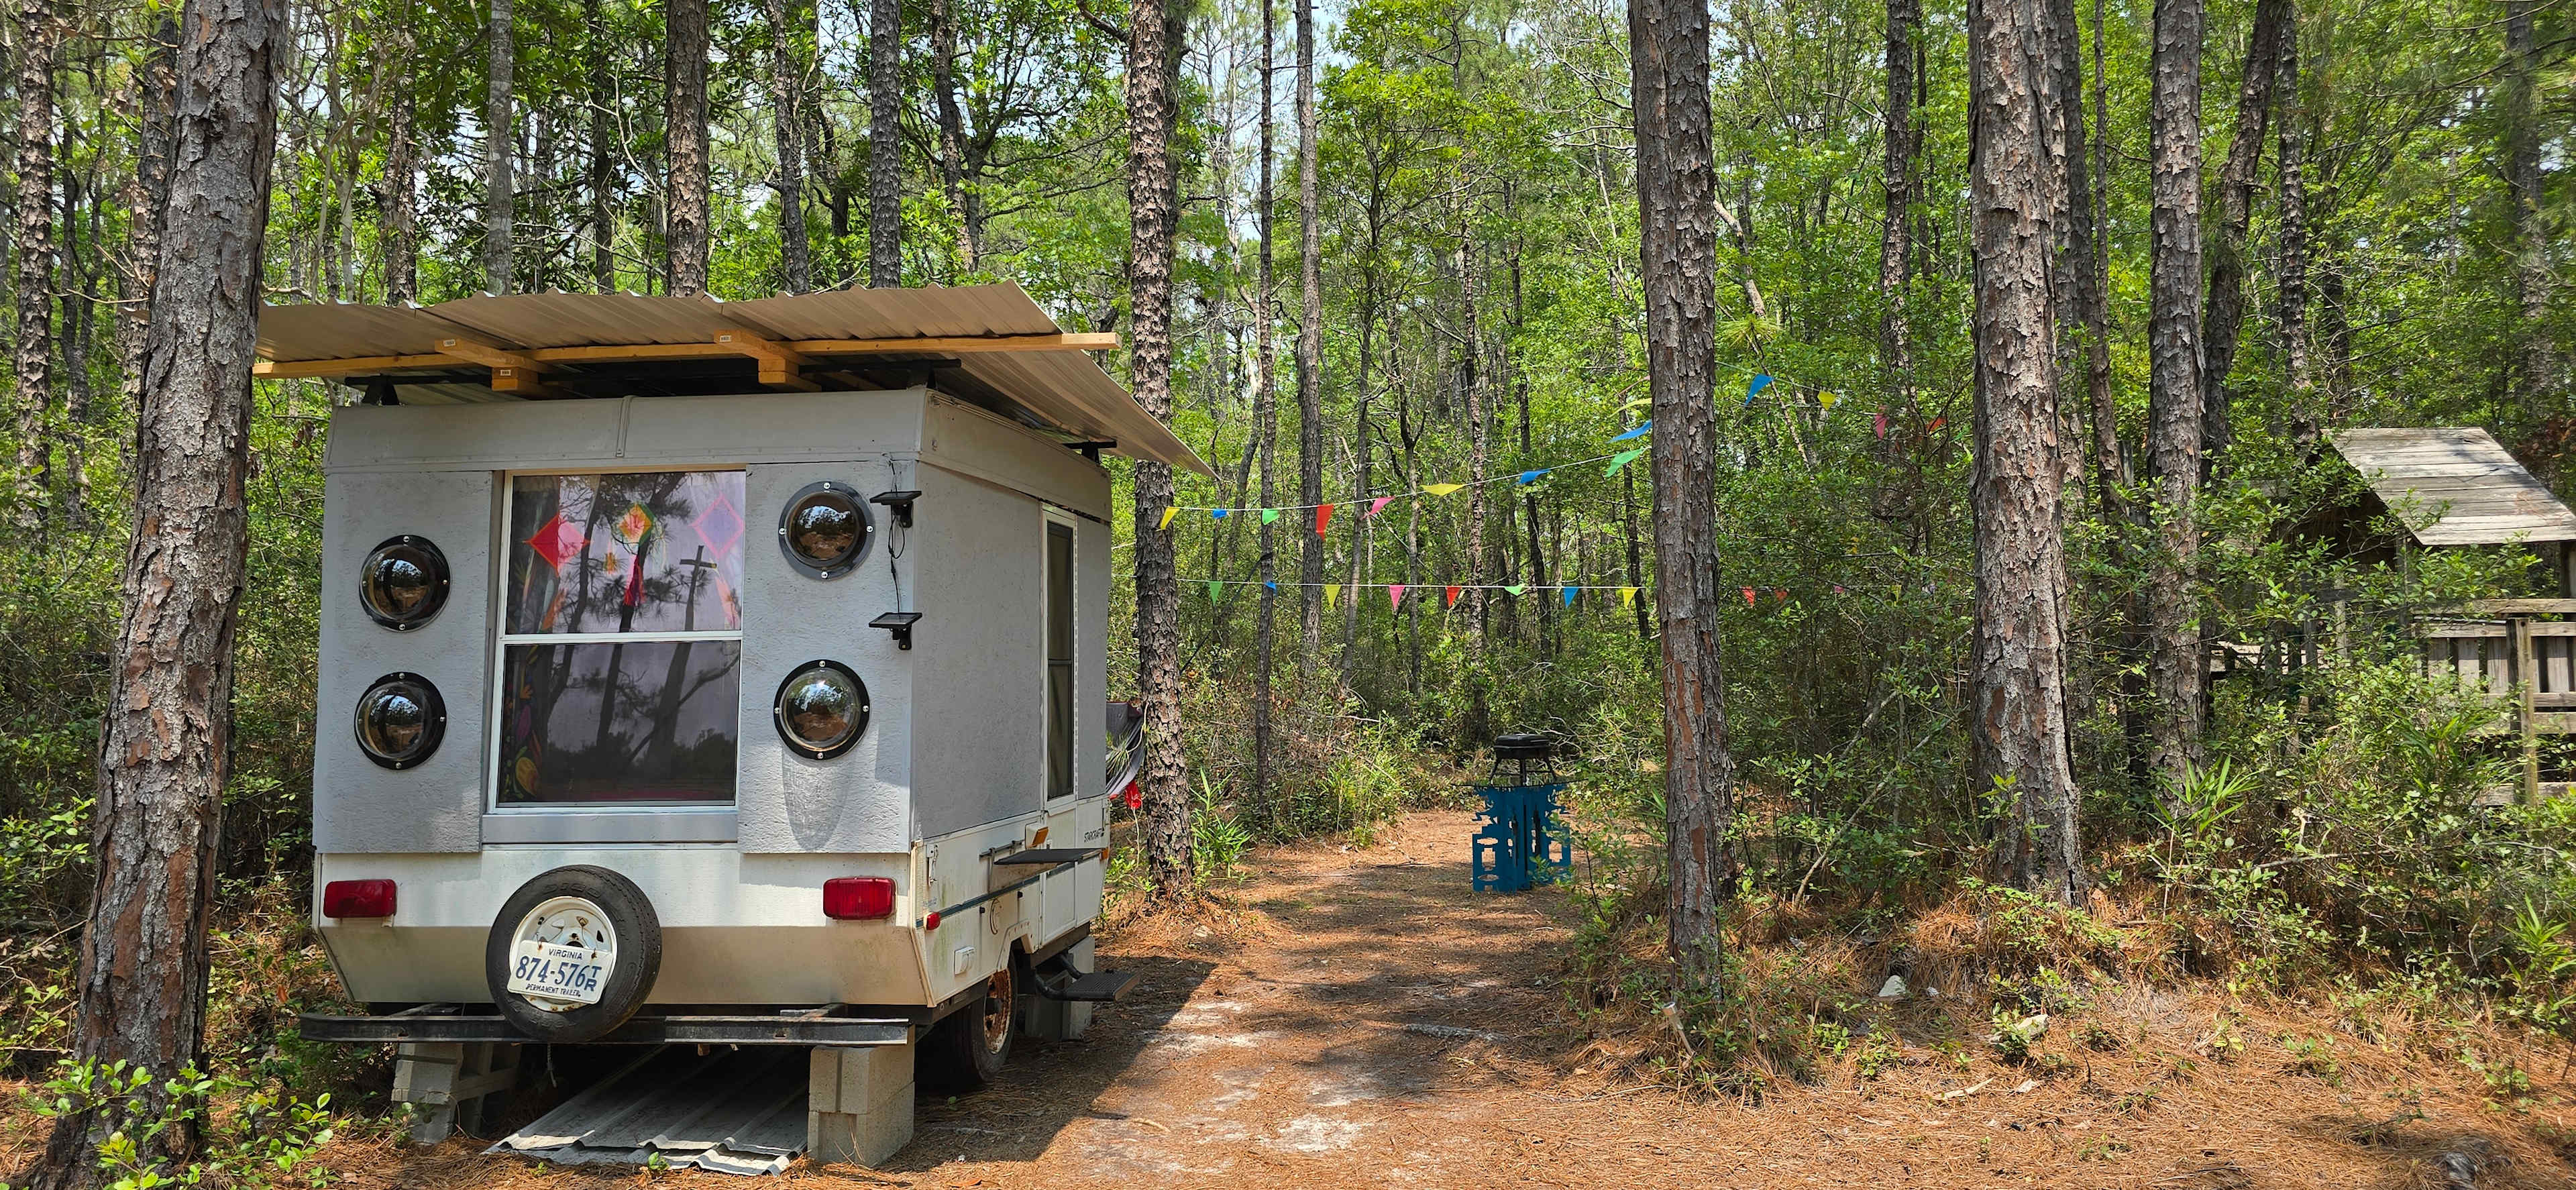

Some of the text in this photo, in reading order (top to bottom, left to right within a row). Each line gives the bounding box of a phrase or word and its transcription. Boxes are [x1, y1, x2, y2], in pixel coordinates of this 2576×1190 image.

[549, 949, 582, 960] VIRGINIA
[516, 955, 590, 987] 874-576
[525, 983, 559, 994] PERMANENT
